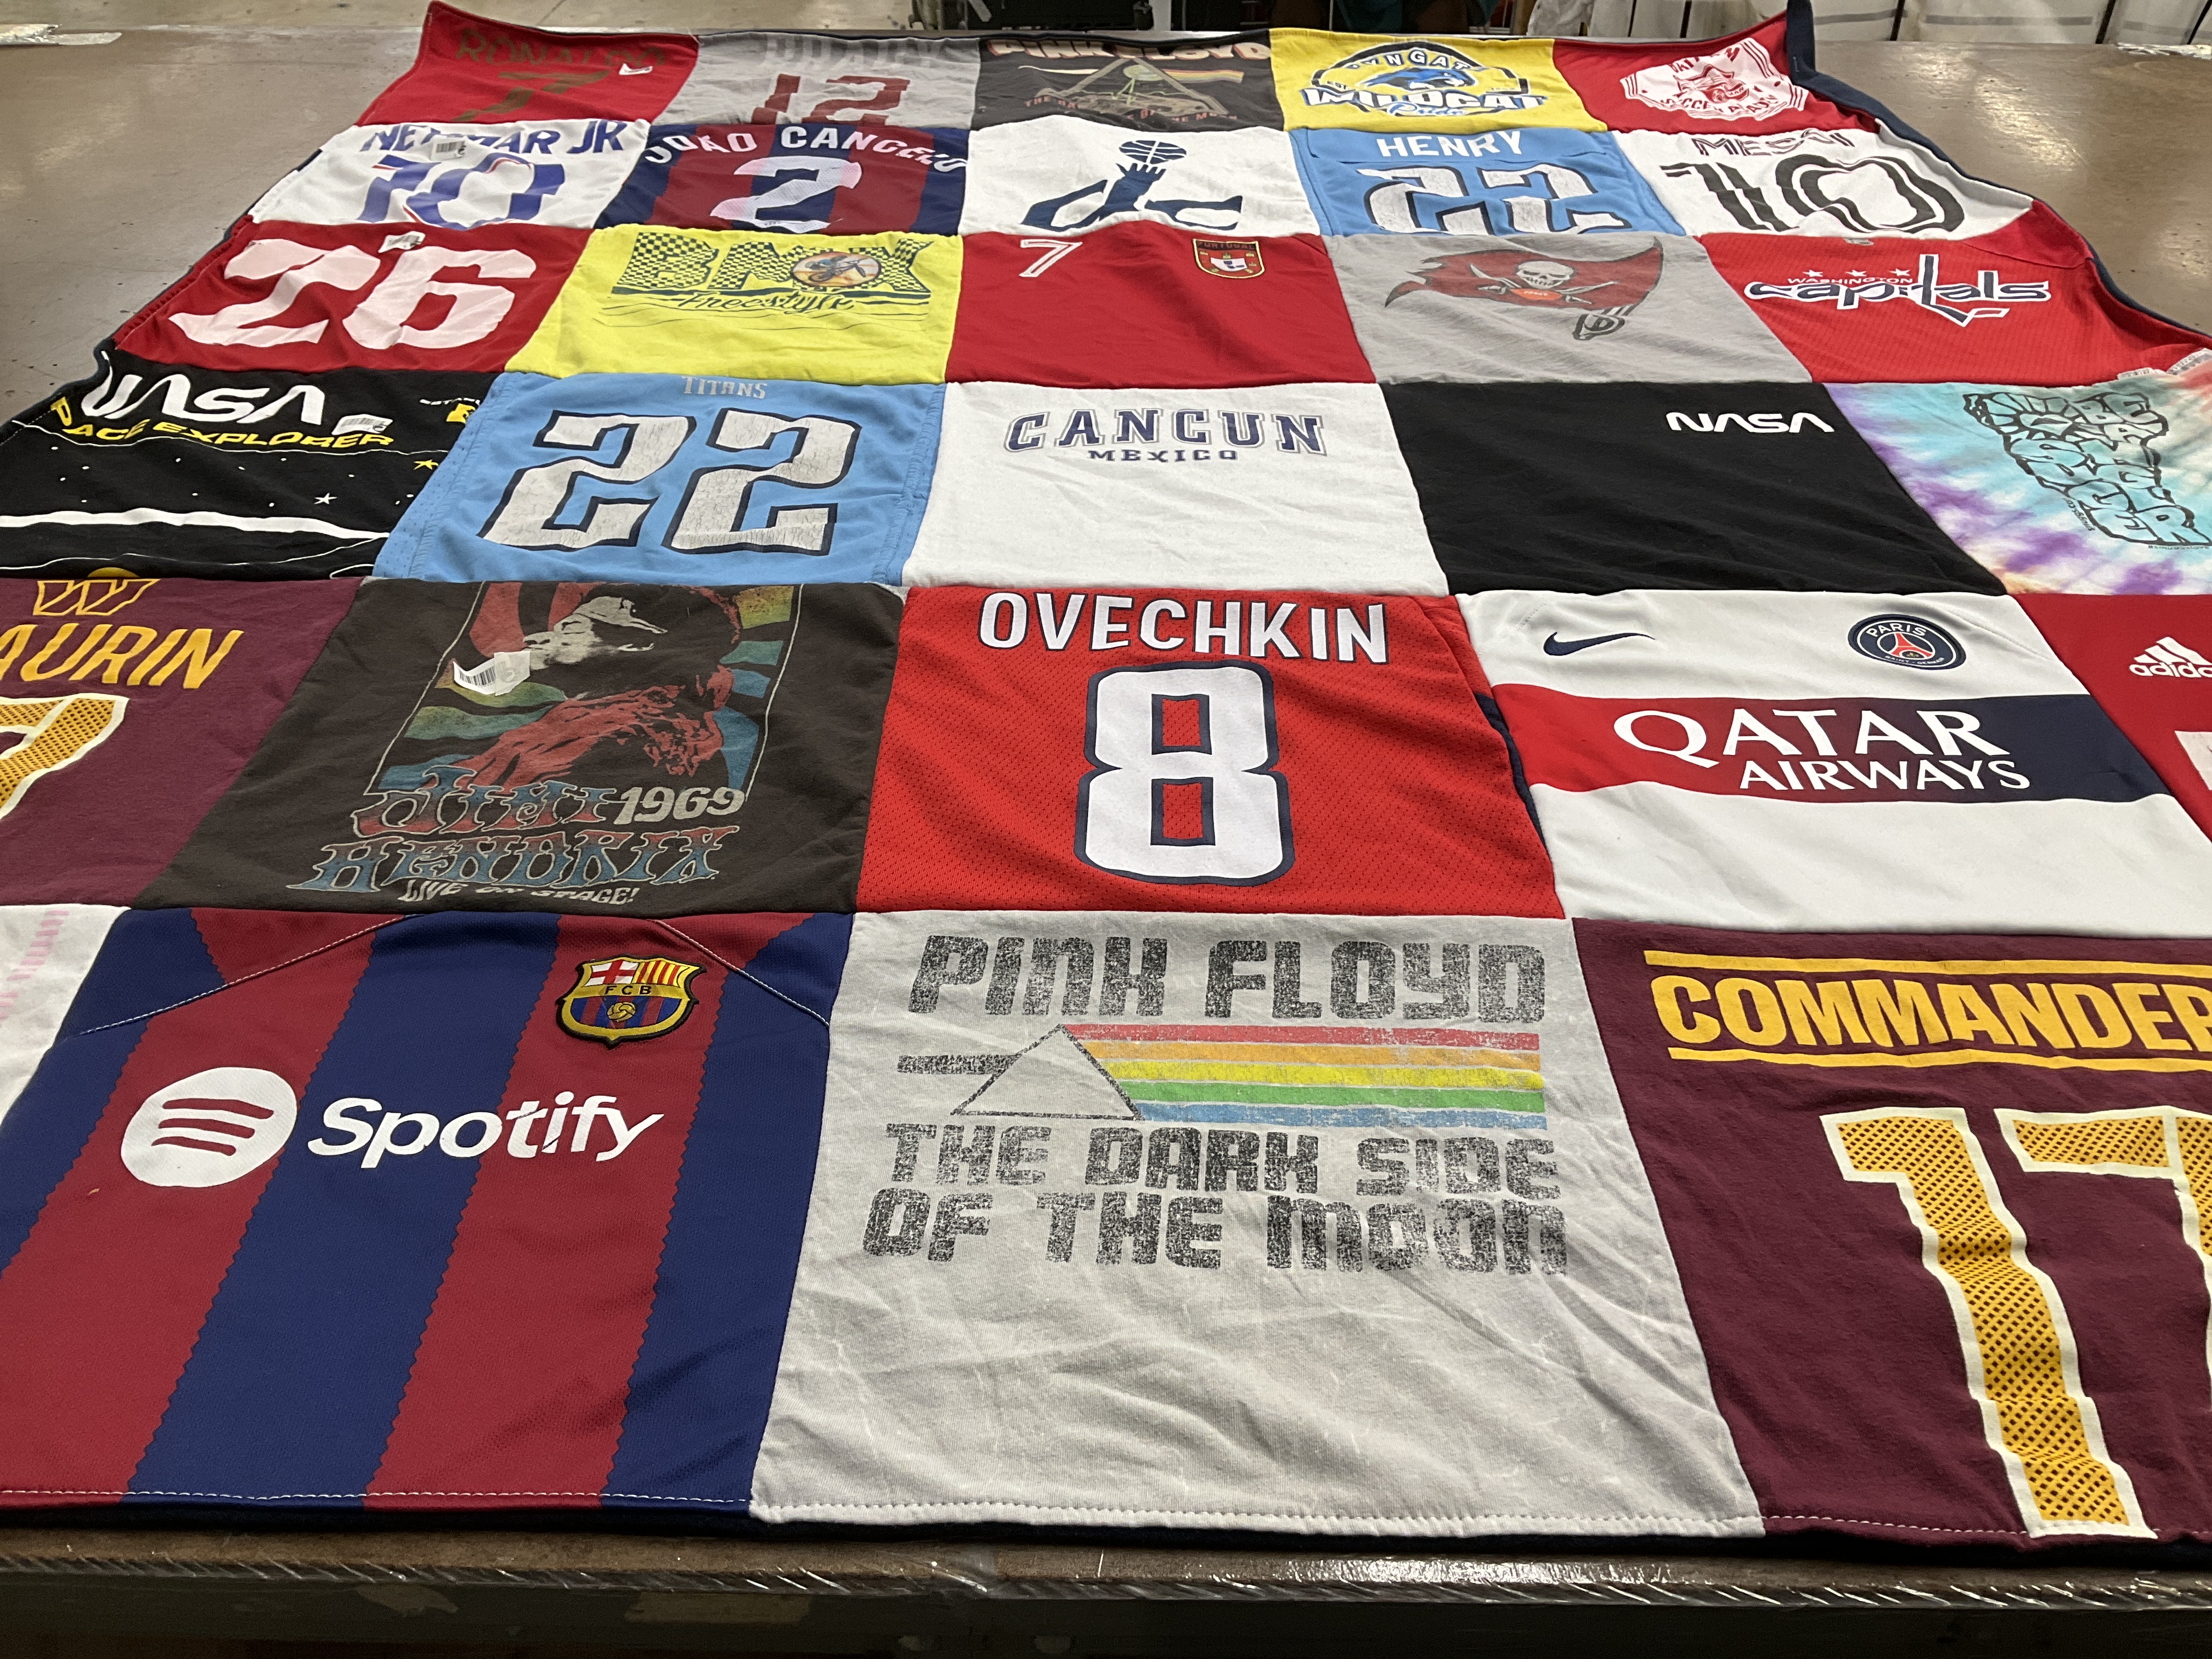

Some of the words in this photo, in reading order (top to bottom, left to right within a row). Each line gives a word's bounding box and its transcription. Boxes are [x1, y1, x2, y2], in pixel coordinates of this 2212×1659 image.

[450, 70, 610, 122] 7
[751, 74, 911, 126] 12
[567, 120, 628, 154] JR
[1376, 131, 1522, 157] HENRY
[710, 155, 862, 234] 2
[1357, 163, 1633, 235] 22
[1660, 154, 1965, 234] 10
[613, 232, 934, 293] BMX
[1019, 239, 1083, 277] 7
[1787, 276, 1913, 285] WASHINGTON
[168, 238, 537, 350] 26
[81, 354, 325, 425] NASA
[681, 376, 768, 399] TITANS
[1003, 408, 1328, 456] CANCUN
[1666, 412, 1835, 433] NASA
[477, 407, 861, 556] 22
[1088, 449, 1239, 462] MEXICO
[978, 591, 1389, 664] OVECHKIN
[1865, 623, 1927, 637] PARIS
[1613, 708, 2011, 768] QATAR
[1073, 659, 1296, 887] 8
[1740, 760, 2031, 791] AIRWAYS
[613, 786, 746, 825] 1969
[285, 825, 740, 893] HENDRIX
[398, 879, 469, 902] LIVE
[531, 887, 640, 905] STAGE!
[907, 935, 1167, 1017] PINK
[1205, 939, 1545, 1023] FLOYD
[307, 1091, 664, 1169] Spotify
[885, 1123, 1052, 1186] THE
[1084, 1126, 1318, 1195] DARK
[1356, 1136, 1561, 1199] SIDE
[861, 1188, 992, 1263] OF
[1037, 1190, 1223, 1269] THE
[1266, 1194, 1567, 1276] MOON
